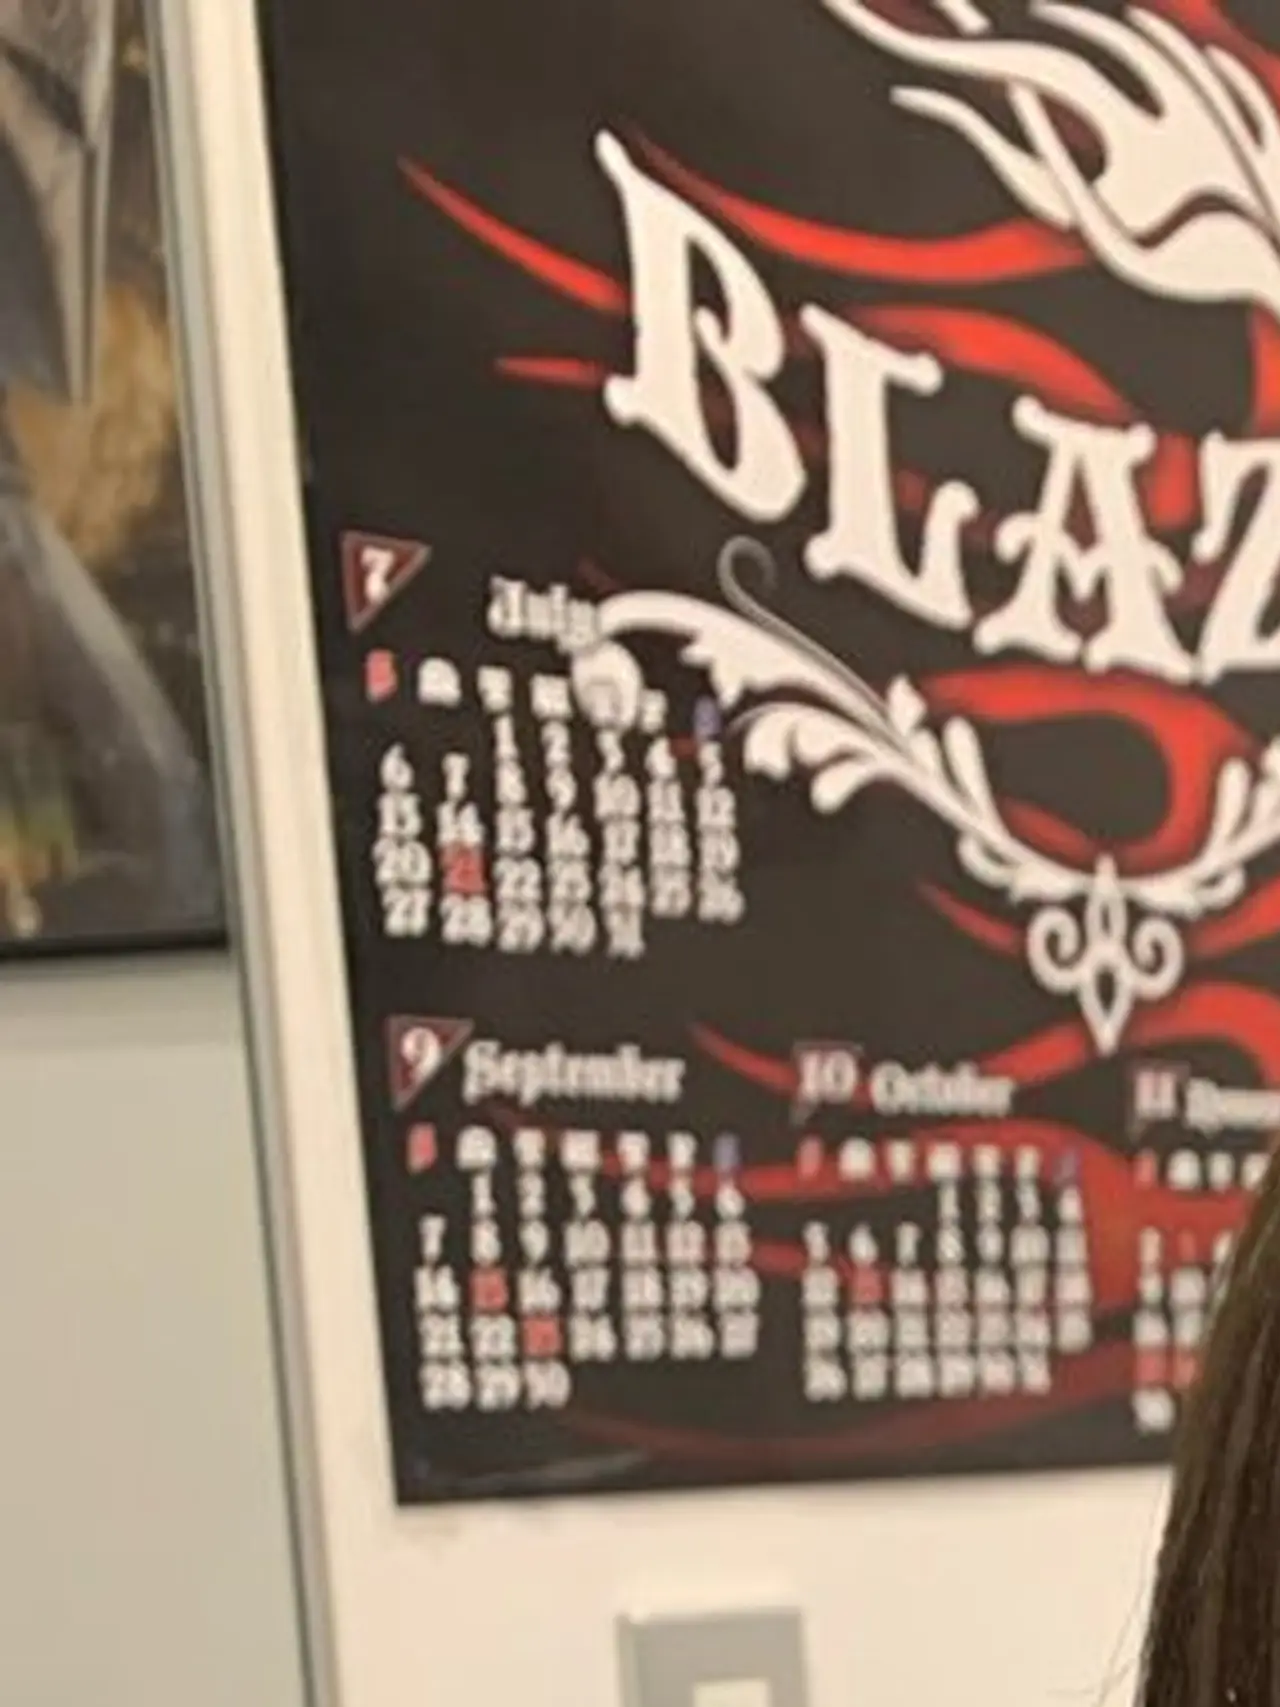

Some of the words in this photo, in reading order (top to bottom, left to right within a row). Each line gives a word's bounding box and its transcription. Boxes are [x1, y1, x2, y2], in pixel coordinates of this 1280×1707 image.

[361, 547, 395, 600] 7
[487, 576, 599, 657] July
[402, 1027, 442, 1080] 9
[462, 1040, 685, 1105] September
[801, 1050, 857, 1103] 10
[871, 1062, 1015, 1116] October
